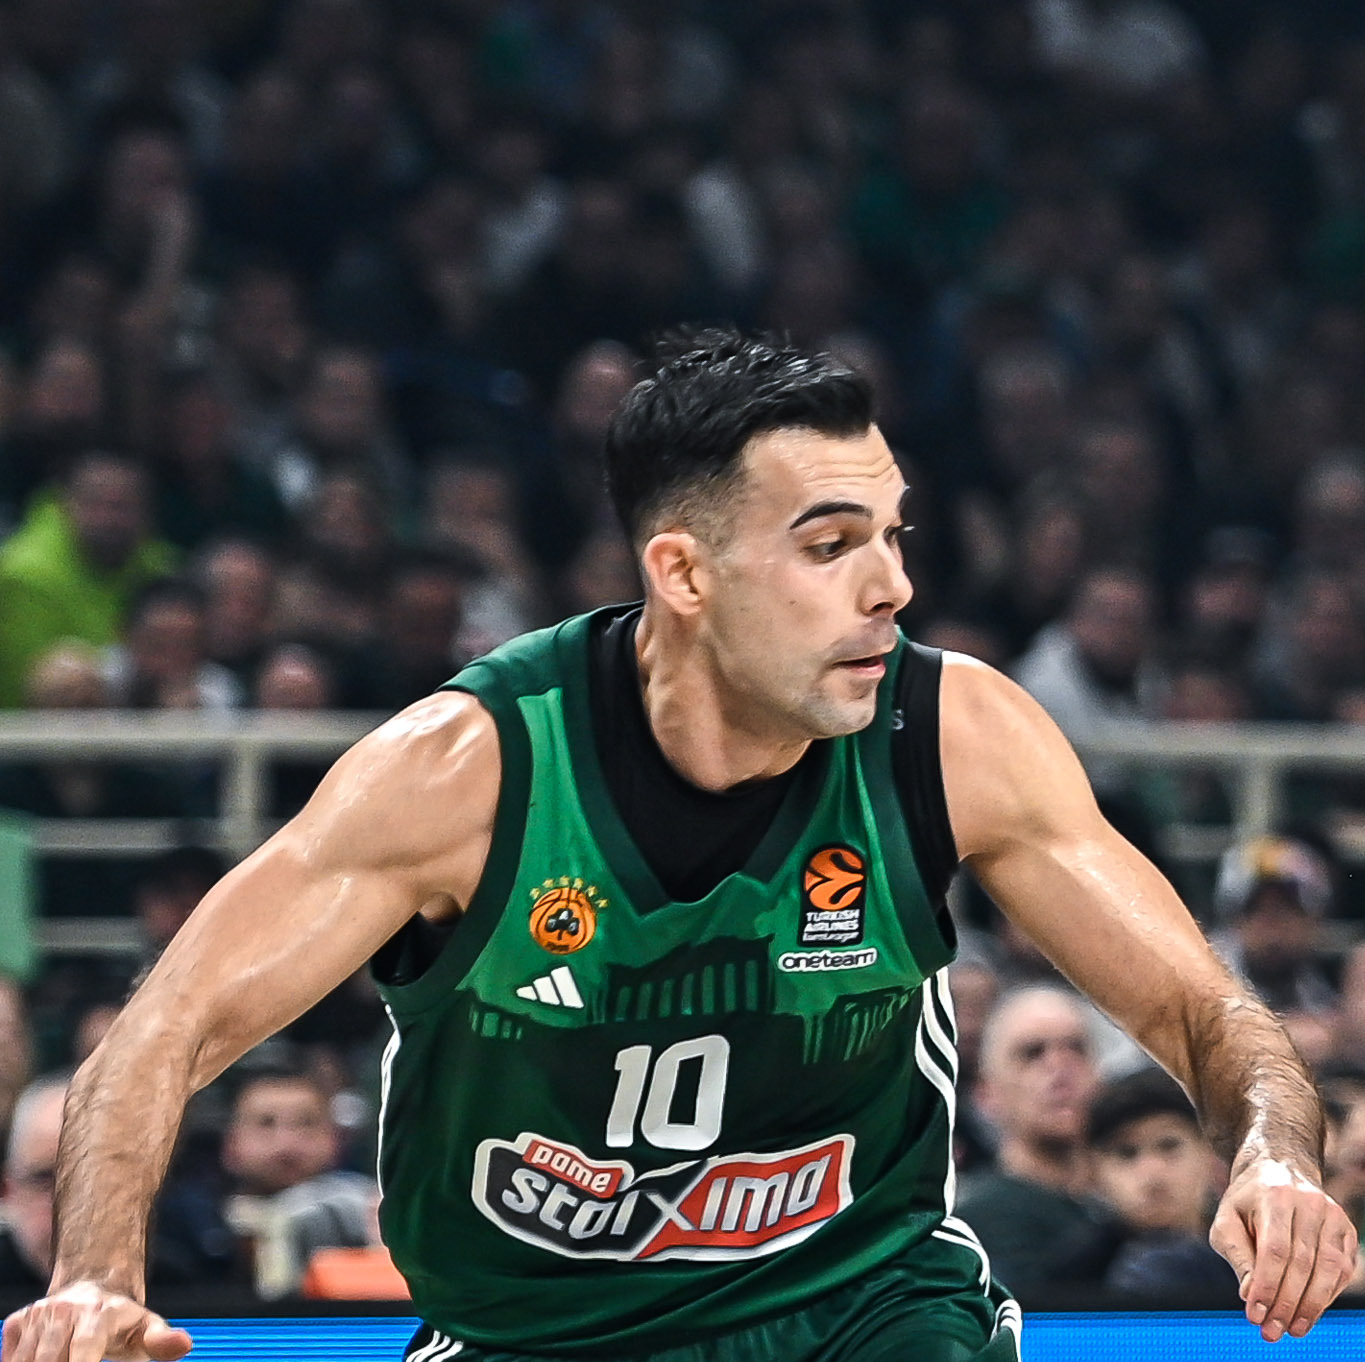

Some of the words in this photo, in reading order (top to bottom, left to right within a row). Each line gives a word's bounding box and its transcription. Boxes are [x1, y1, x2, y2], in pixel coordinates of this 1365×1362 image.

[782, 952, 875, 969] oneteam
[606, 1034, 731, 1151] 10
[530, 1144, 612, 1193] pame
